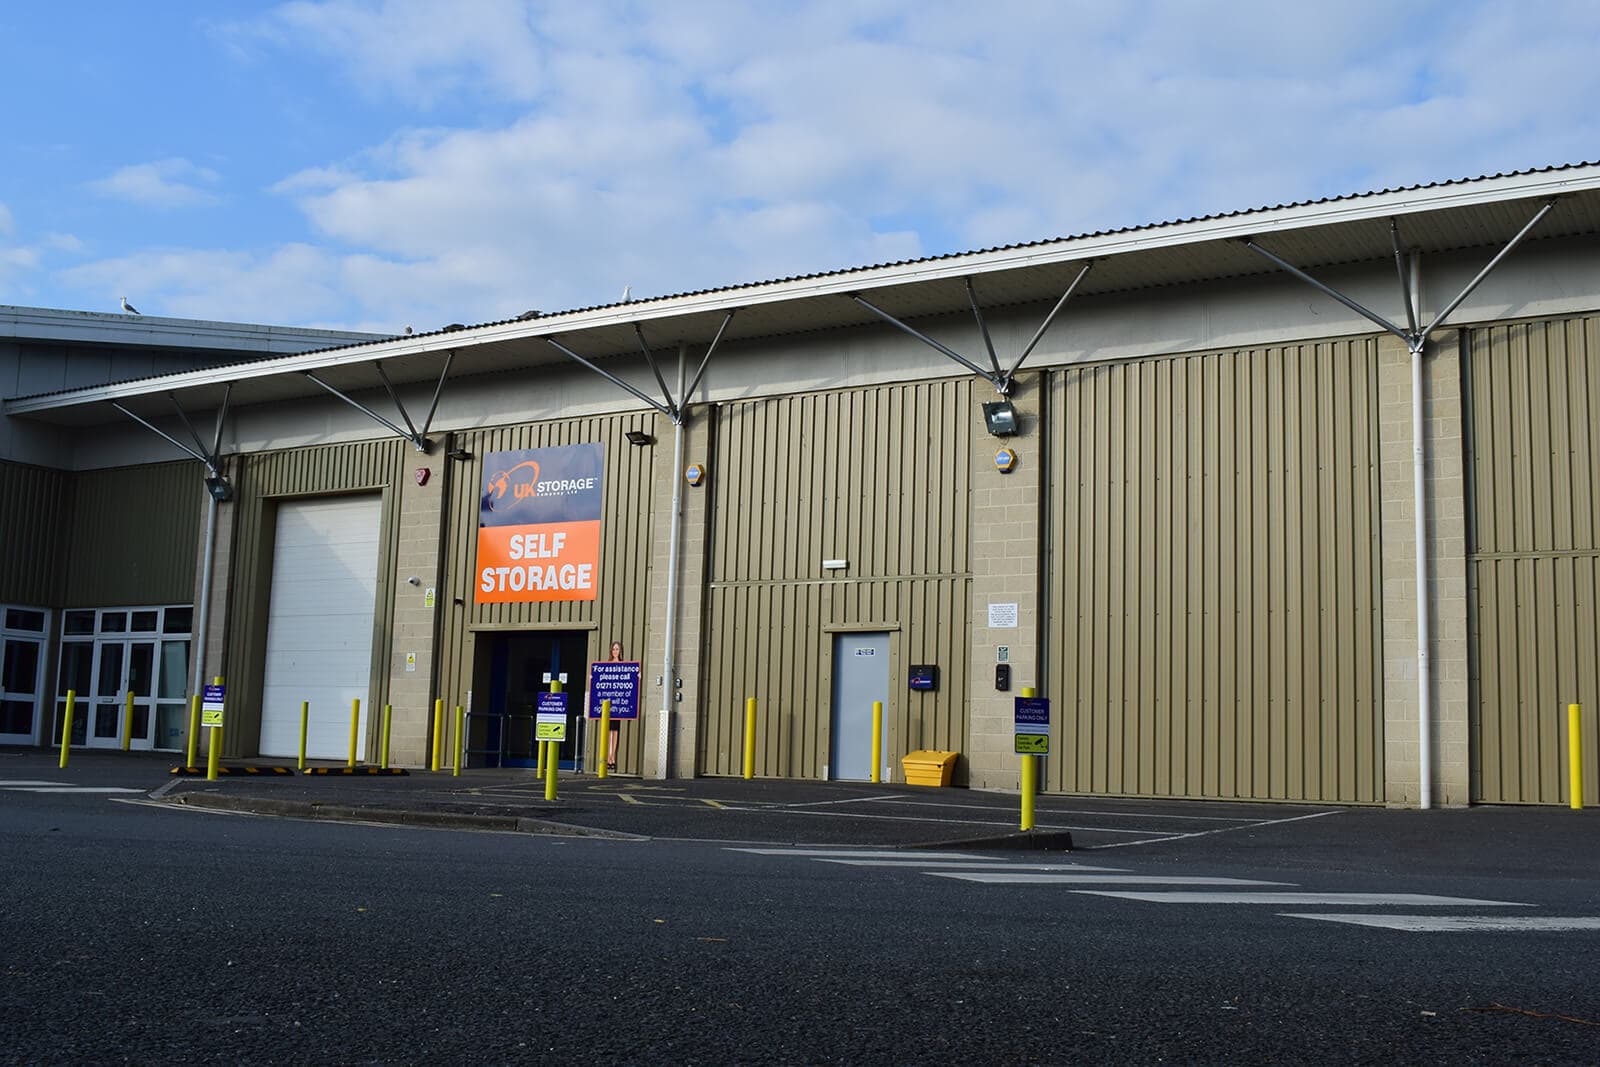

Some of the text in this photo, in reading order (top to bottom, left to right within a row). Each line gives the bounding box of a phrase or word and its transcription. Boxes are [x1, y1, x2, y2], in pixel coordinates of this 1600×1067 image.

[514, 478, 593, 499] UK STORAGE
[509, 532, 566, 560] SELF
[481, 563, 592, 592] STORAGE
[600, 673, 618, 681] please
